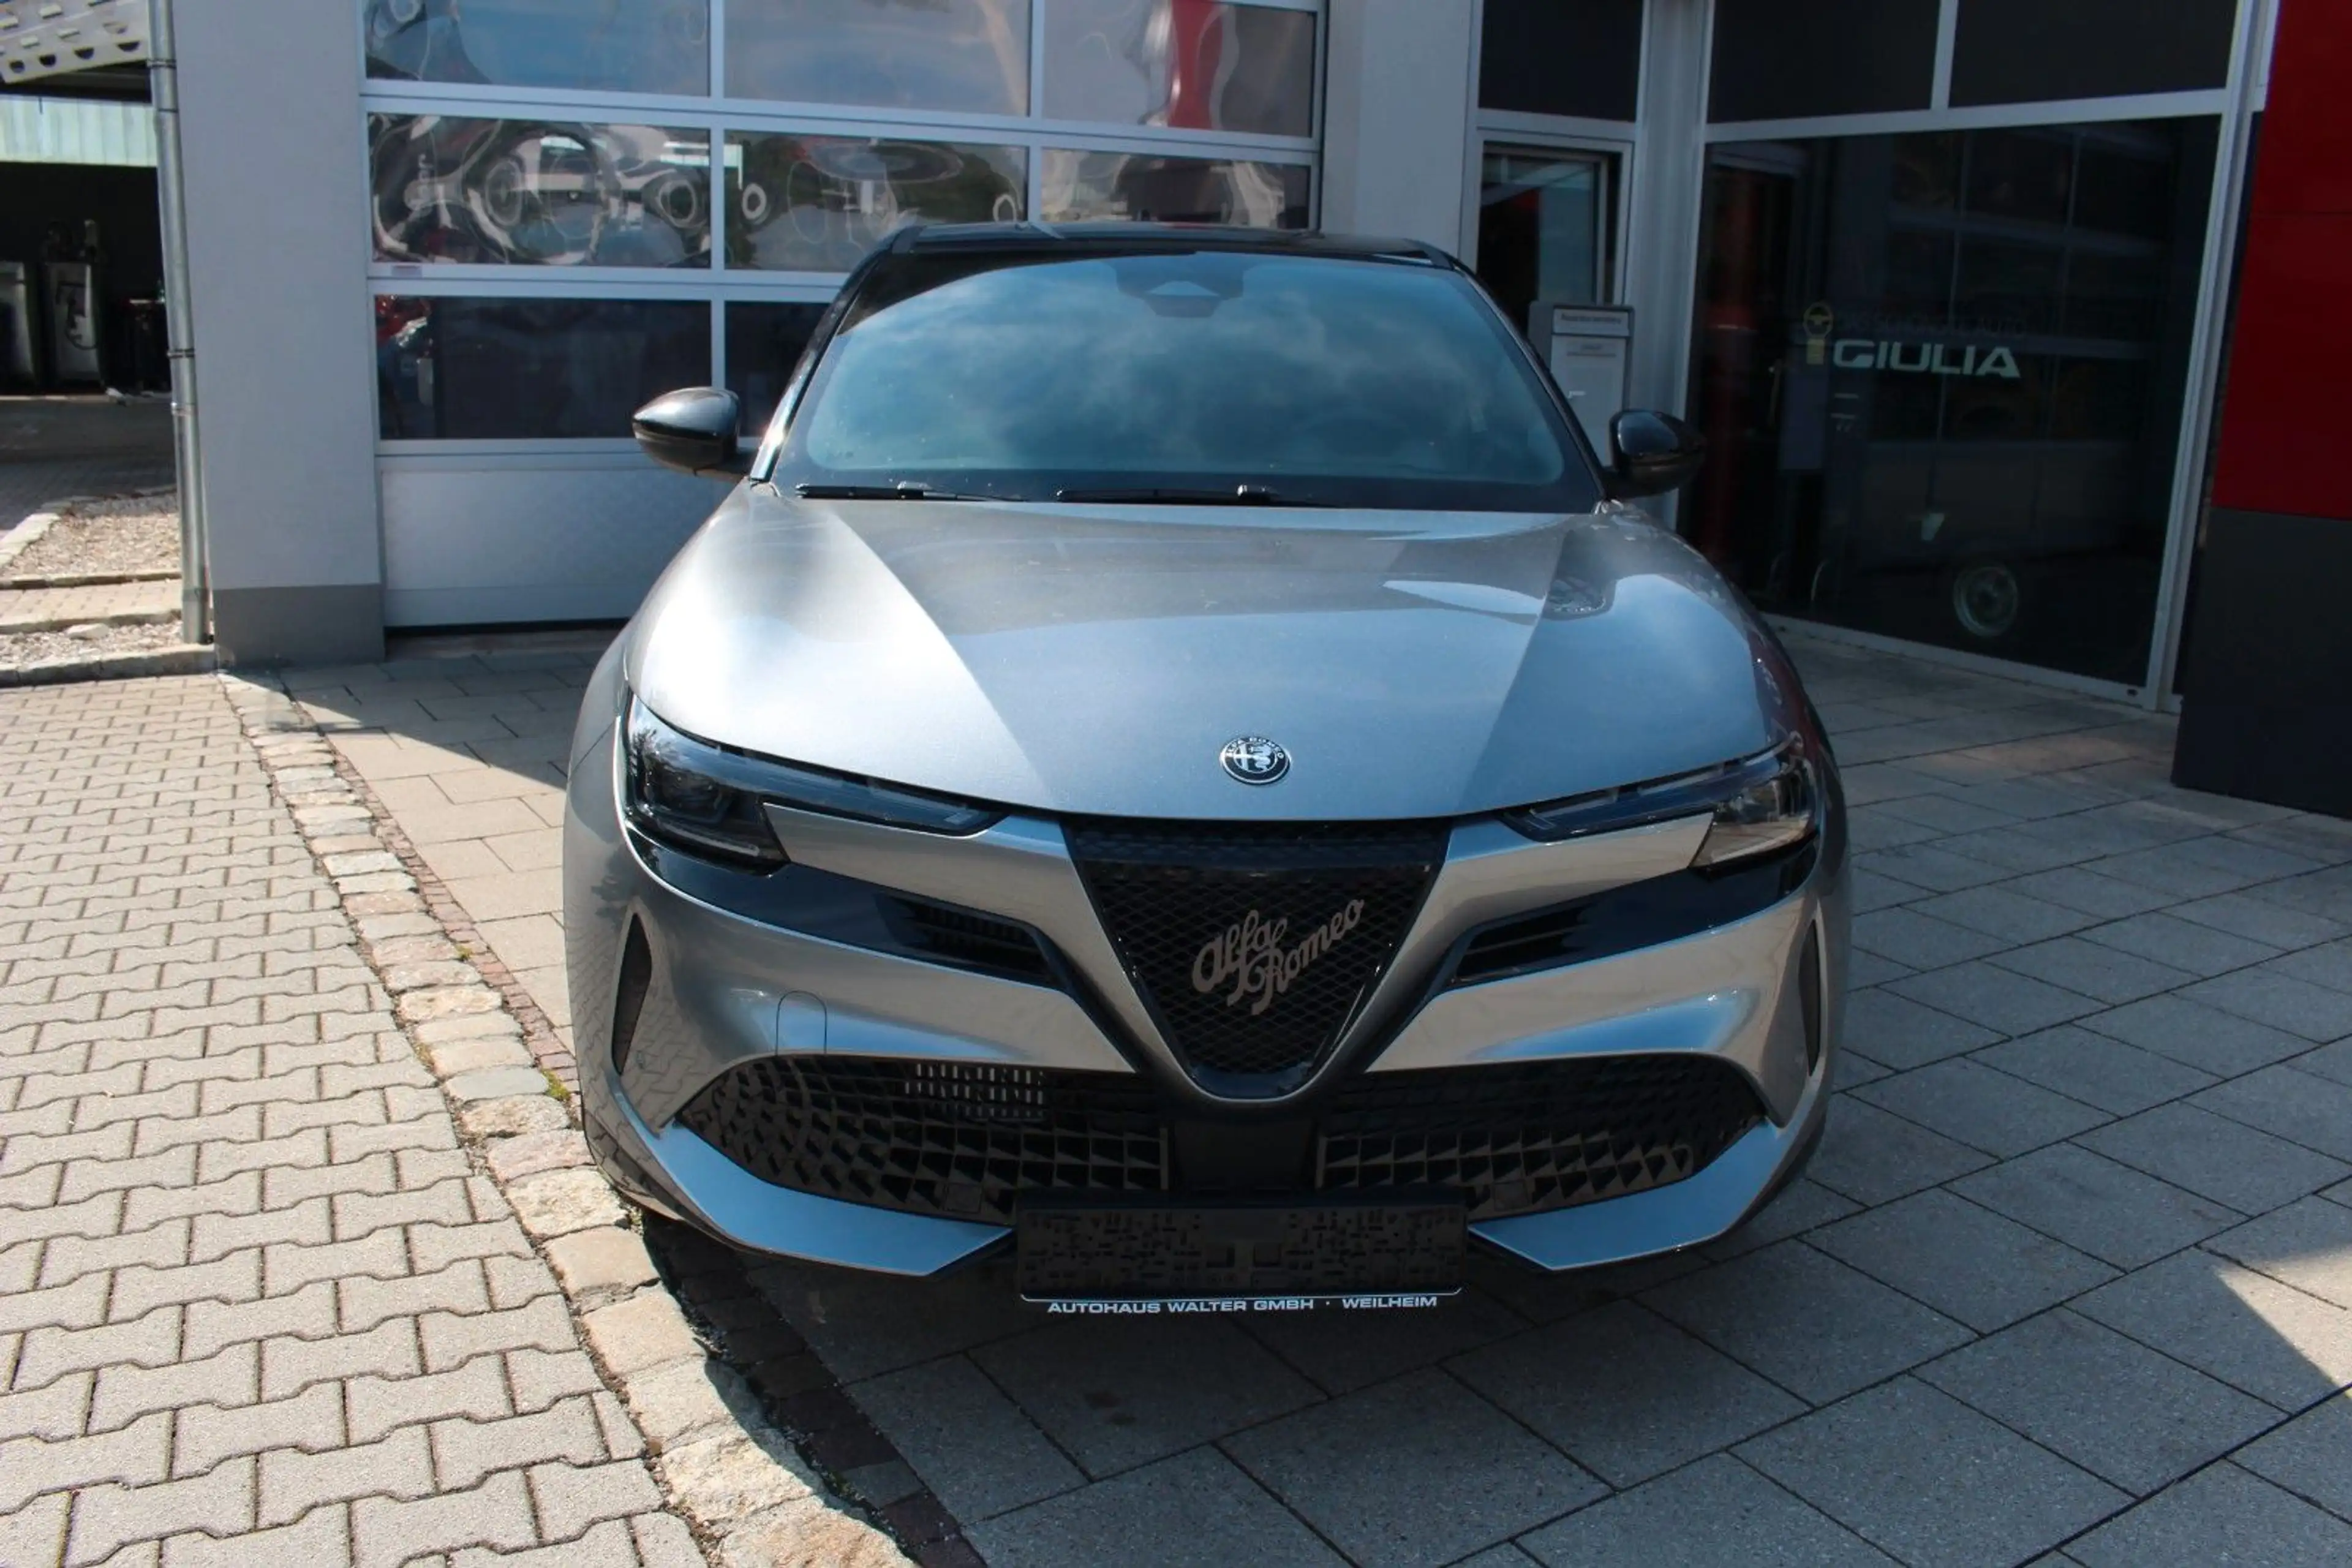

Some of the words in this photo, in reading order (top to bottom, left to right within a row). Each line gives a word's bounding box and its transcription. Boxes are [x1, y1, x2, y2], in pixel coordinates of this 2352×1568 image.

[1833, 339, 2020, 377] GIULIA
[1192, 910, 1287, 1006] Alfa
[1245, 899, 1365, 1015] Romeo
[1047, 1302, 1161, 1314] AUTOHAUS
[1167, 1300, 1247, 1313] WALTER
[1253, 1298, 1314, 1311] GMBH
[1341, 1296, 1438, 1309] WEILHEIM
